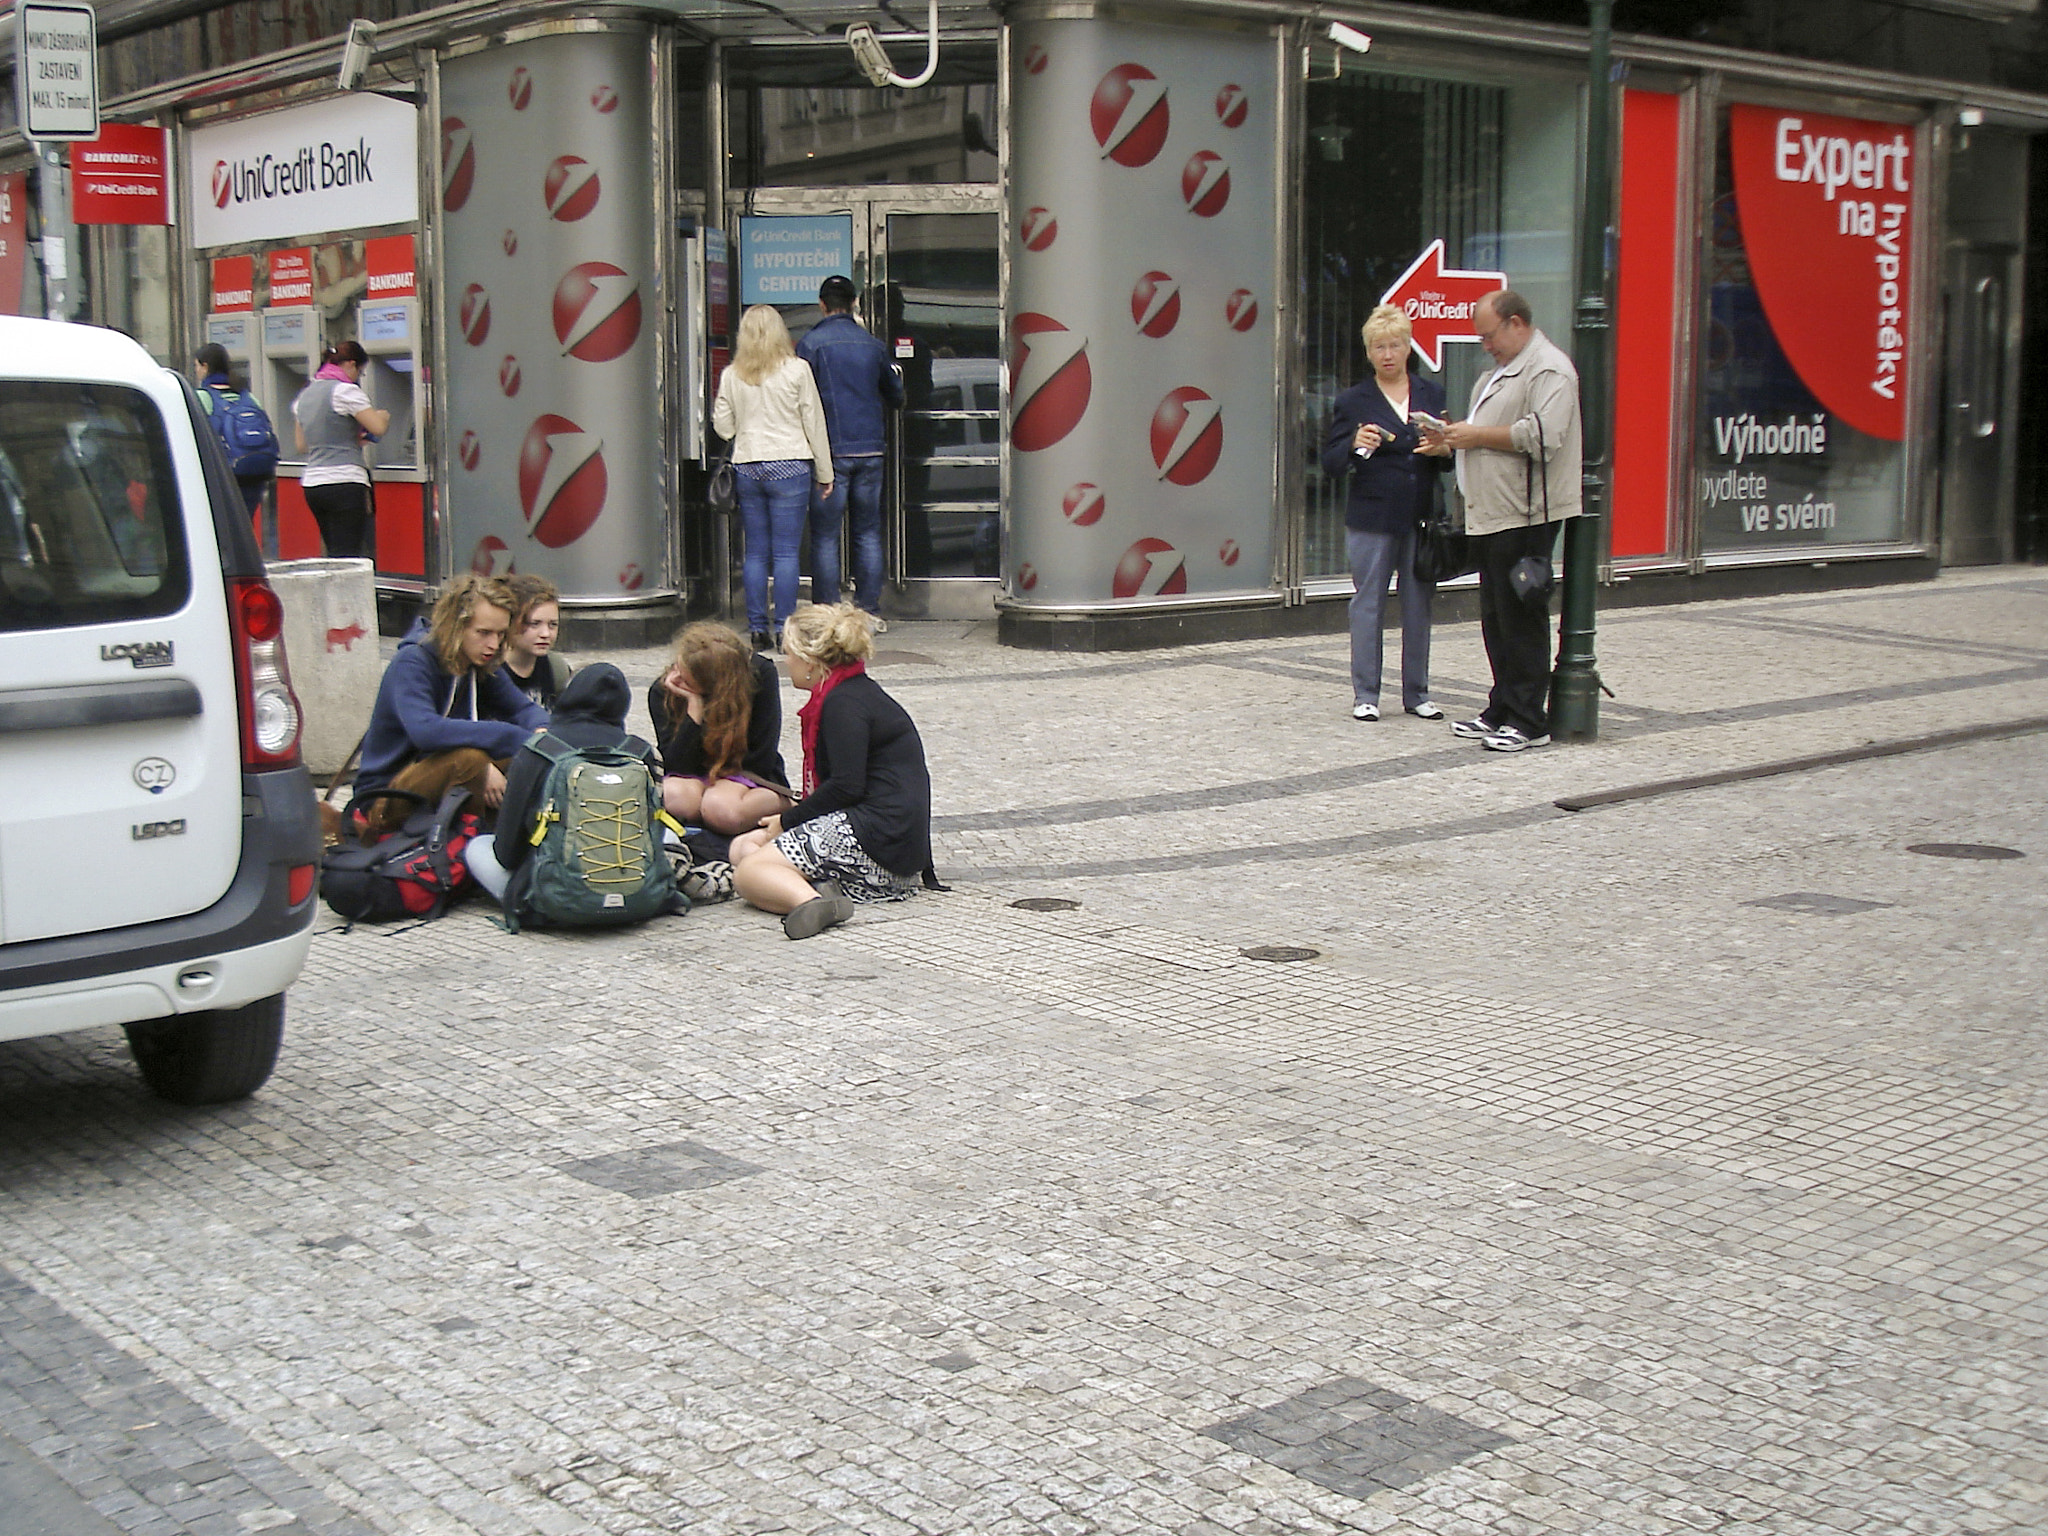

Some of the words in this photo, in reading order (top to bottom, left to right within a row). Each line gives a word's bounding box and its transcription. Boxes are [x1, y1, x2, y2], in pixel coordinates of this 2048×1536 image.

[56, 91, 65, 109] 15
[84, 151, 139, 164] BANKOMAT
[1775, 117, 1909, 201] Expert
[233, 147, 316, 203] UniCredit
[320, 136, 373, 189] Bank
[98, 183, 138, 195] UniCredit
[138, 184, 159, 196] Bank
[1839, 200, 1876, 236] na
[764, 229, 812, 242] UniCredit
[814, 228, 841, 242] Bank
[754, 247, 840, 268] HYPOTEČNÍ
[272, 282, 312, 299] BANKOMAT
[369, 271, 415, 291] BANKOMAT
[760, 275, 828, 292] CENTRU
[216, 289, 253, 306] BANKOMAT
[1870, 203, 1907, 399] hypotéky
[1420, 301, 1469, 319] UniCredit
[1714, 412, 1826, 464] Výhodně
[1741, 504, 1769, 532] ve
[1775, 492, 1835, 531] svém
[100, 640, 174, 661] LOGAN
[138, 765, 168, 784] CZ
